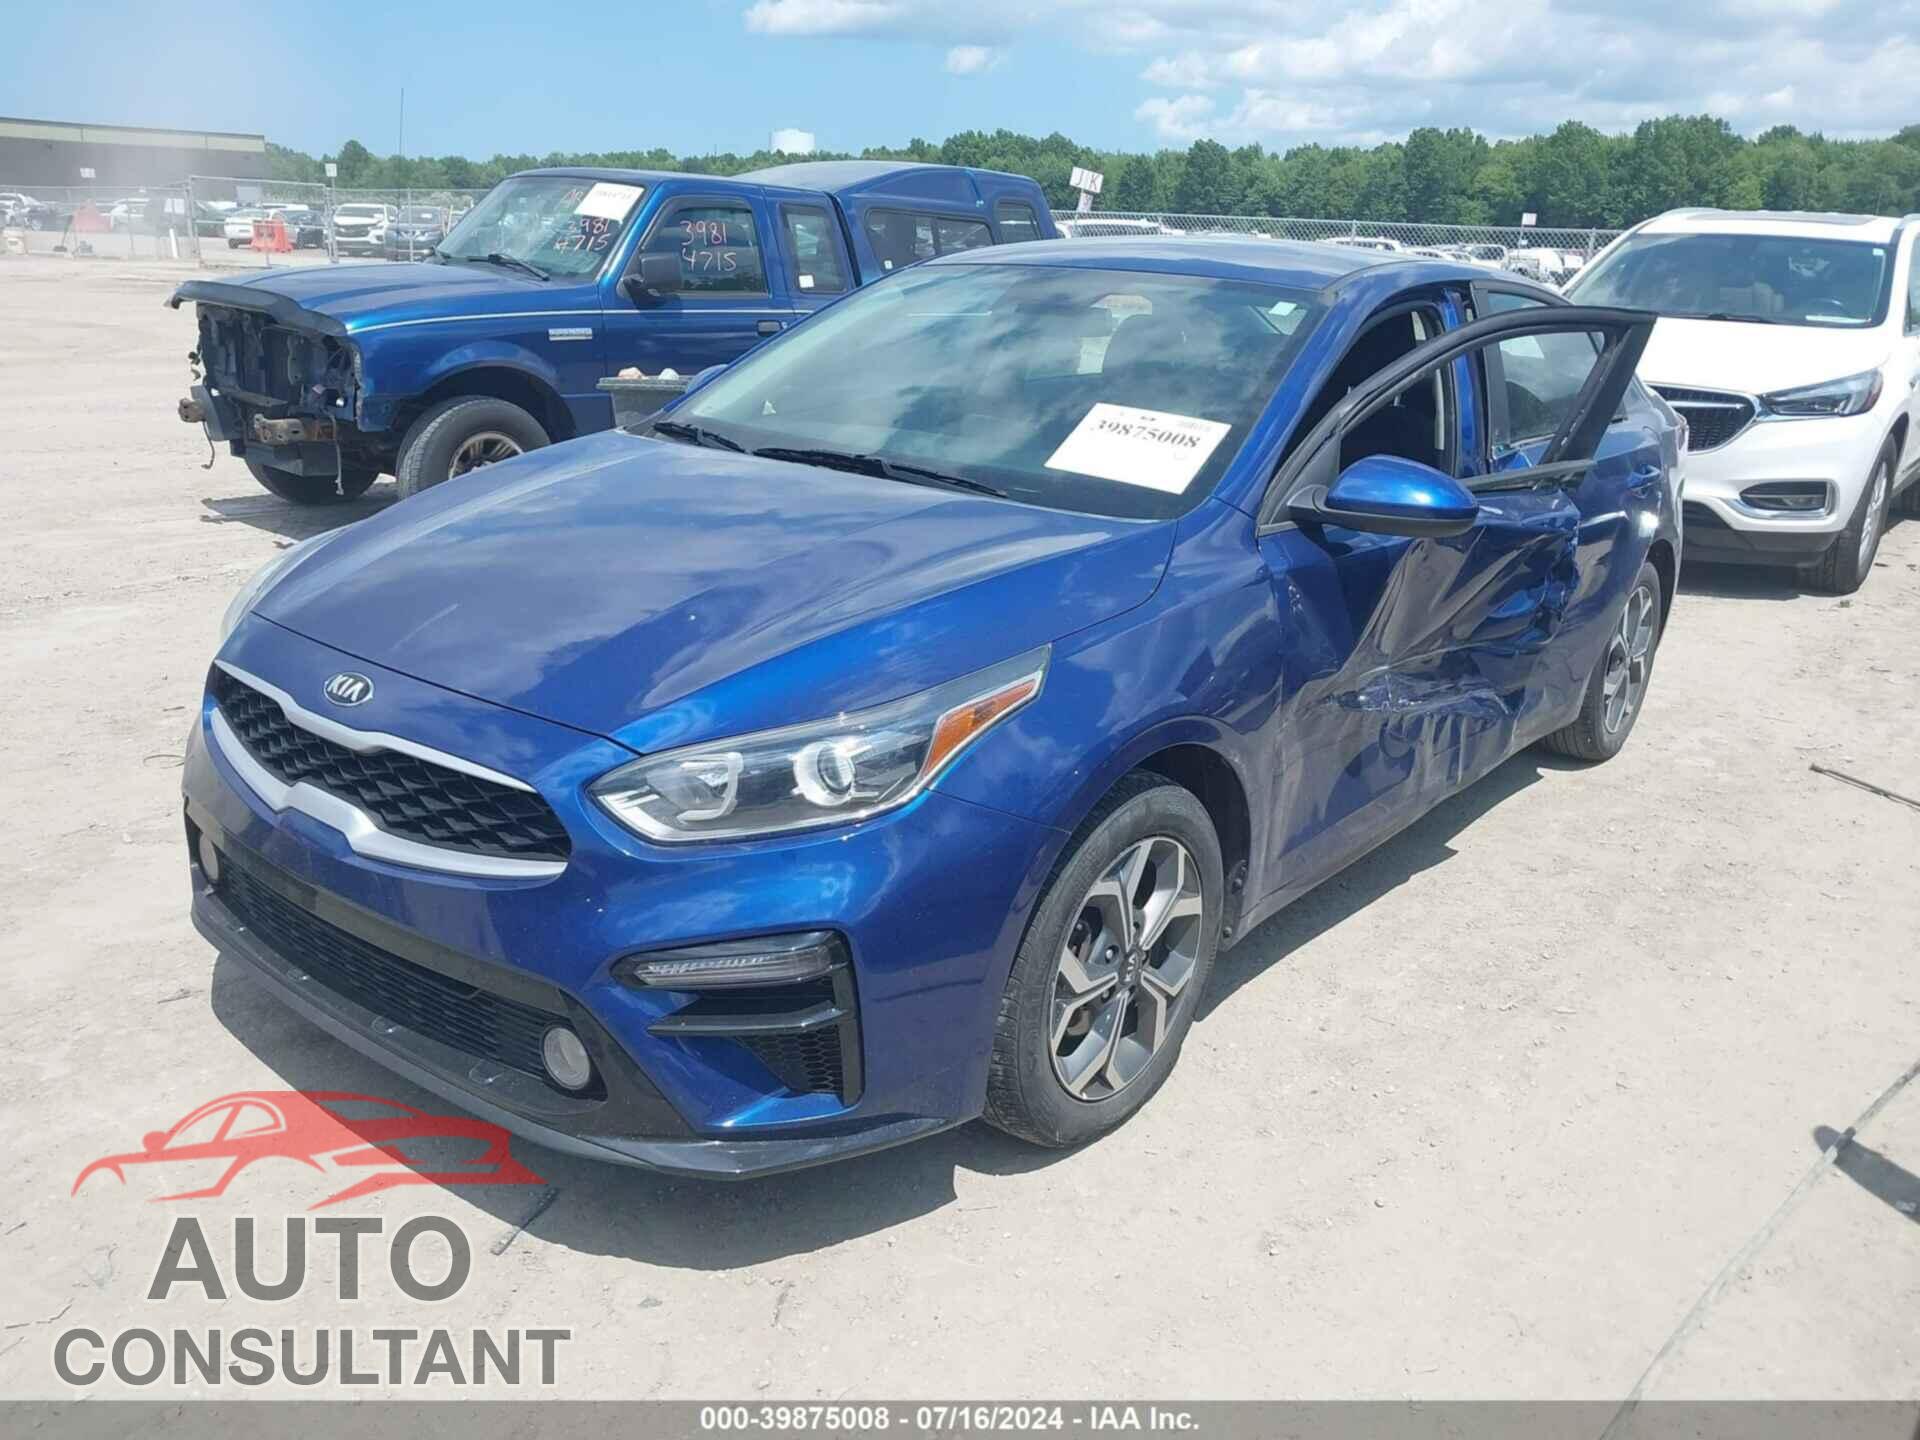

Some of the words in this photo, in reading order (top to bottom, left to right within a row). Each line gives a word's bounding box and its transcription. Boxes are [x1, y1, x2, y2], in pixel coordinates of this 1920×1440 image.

[680, 220, 728, 246] 3981
[682, 247, 737, 272] 4715
[1091, 418, 1202, 449] 39875008
[327, 674, 365, 702] KIA
